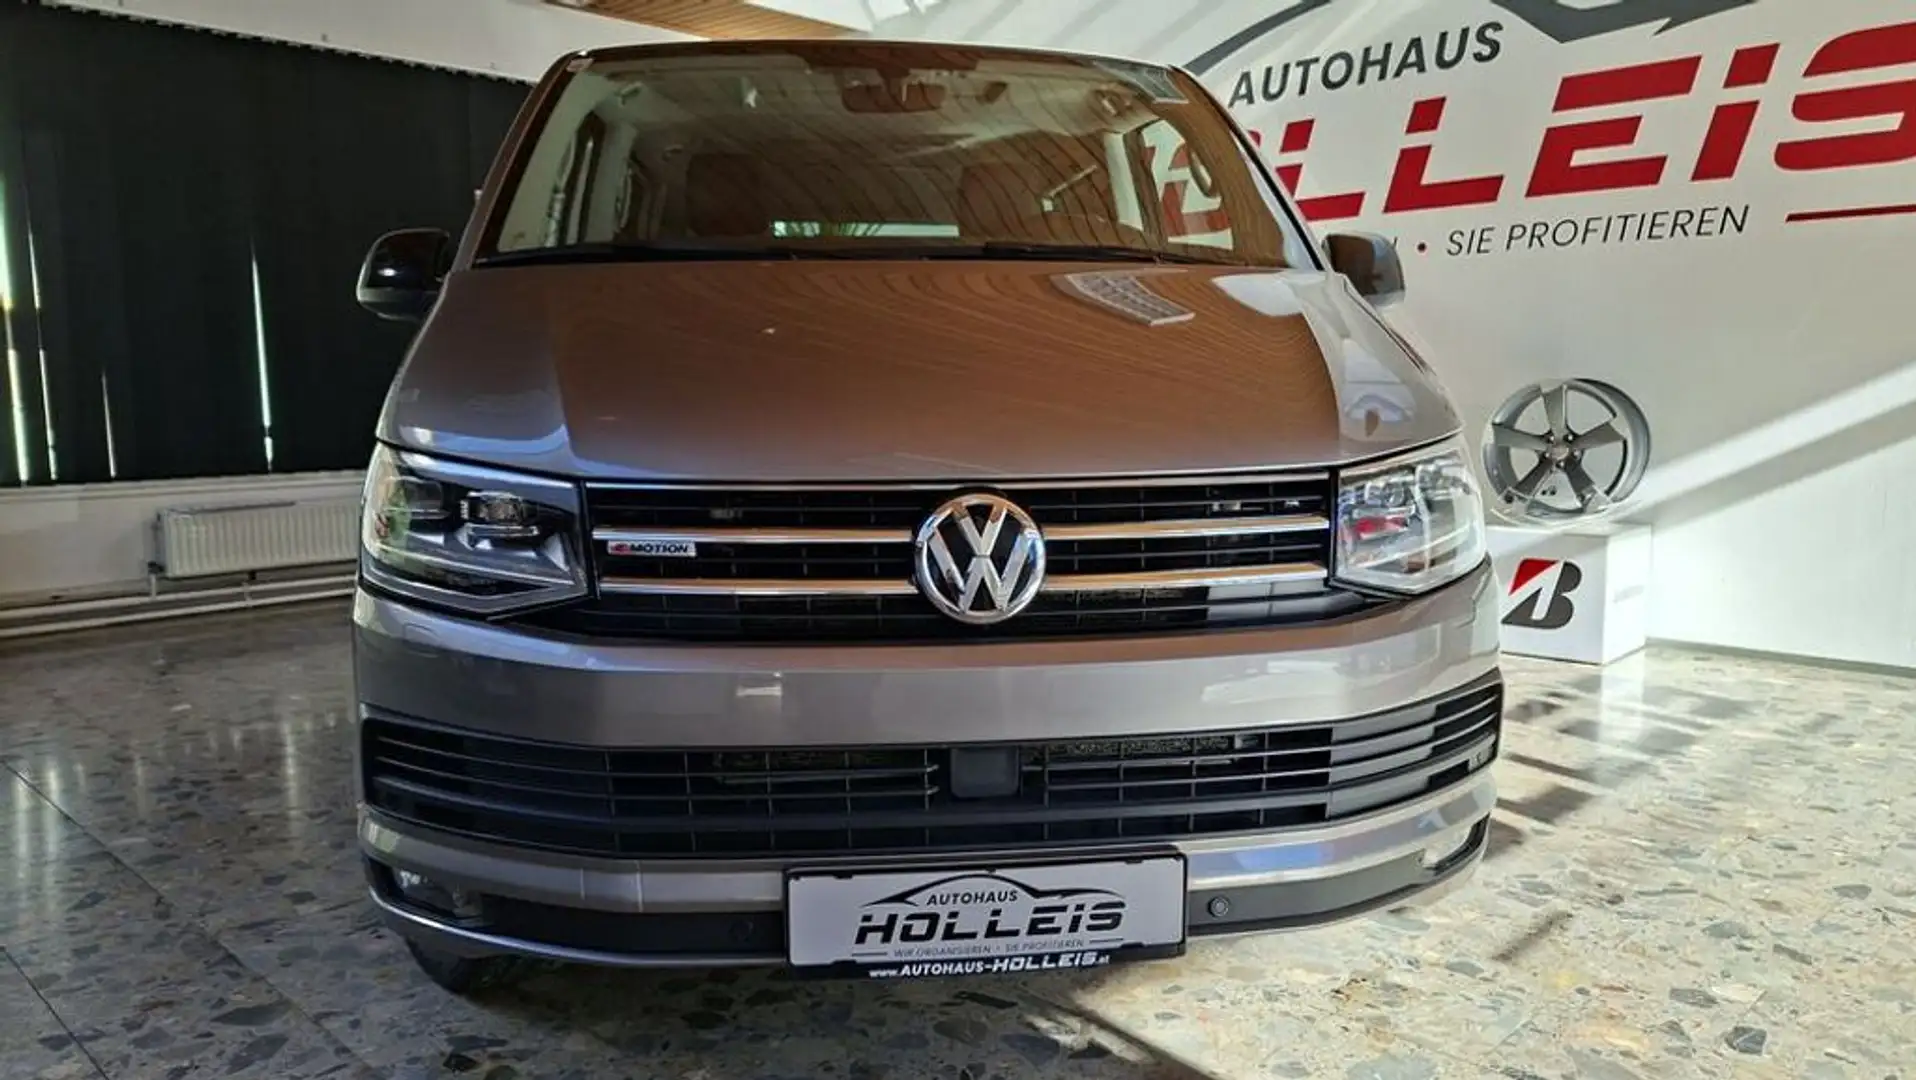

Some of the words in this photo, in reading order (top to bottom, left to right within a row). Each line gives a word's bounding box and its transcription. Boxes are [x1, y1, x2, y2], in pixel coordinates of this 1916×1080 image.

[1228, 21, 1504, 108] AUTOHAUS
[1446, 227, 1495, 256] SIE
[1506, 205, 1749, 250] PROFITIEREN
[926, 890, 1018, 906] AUTOHAUS
